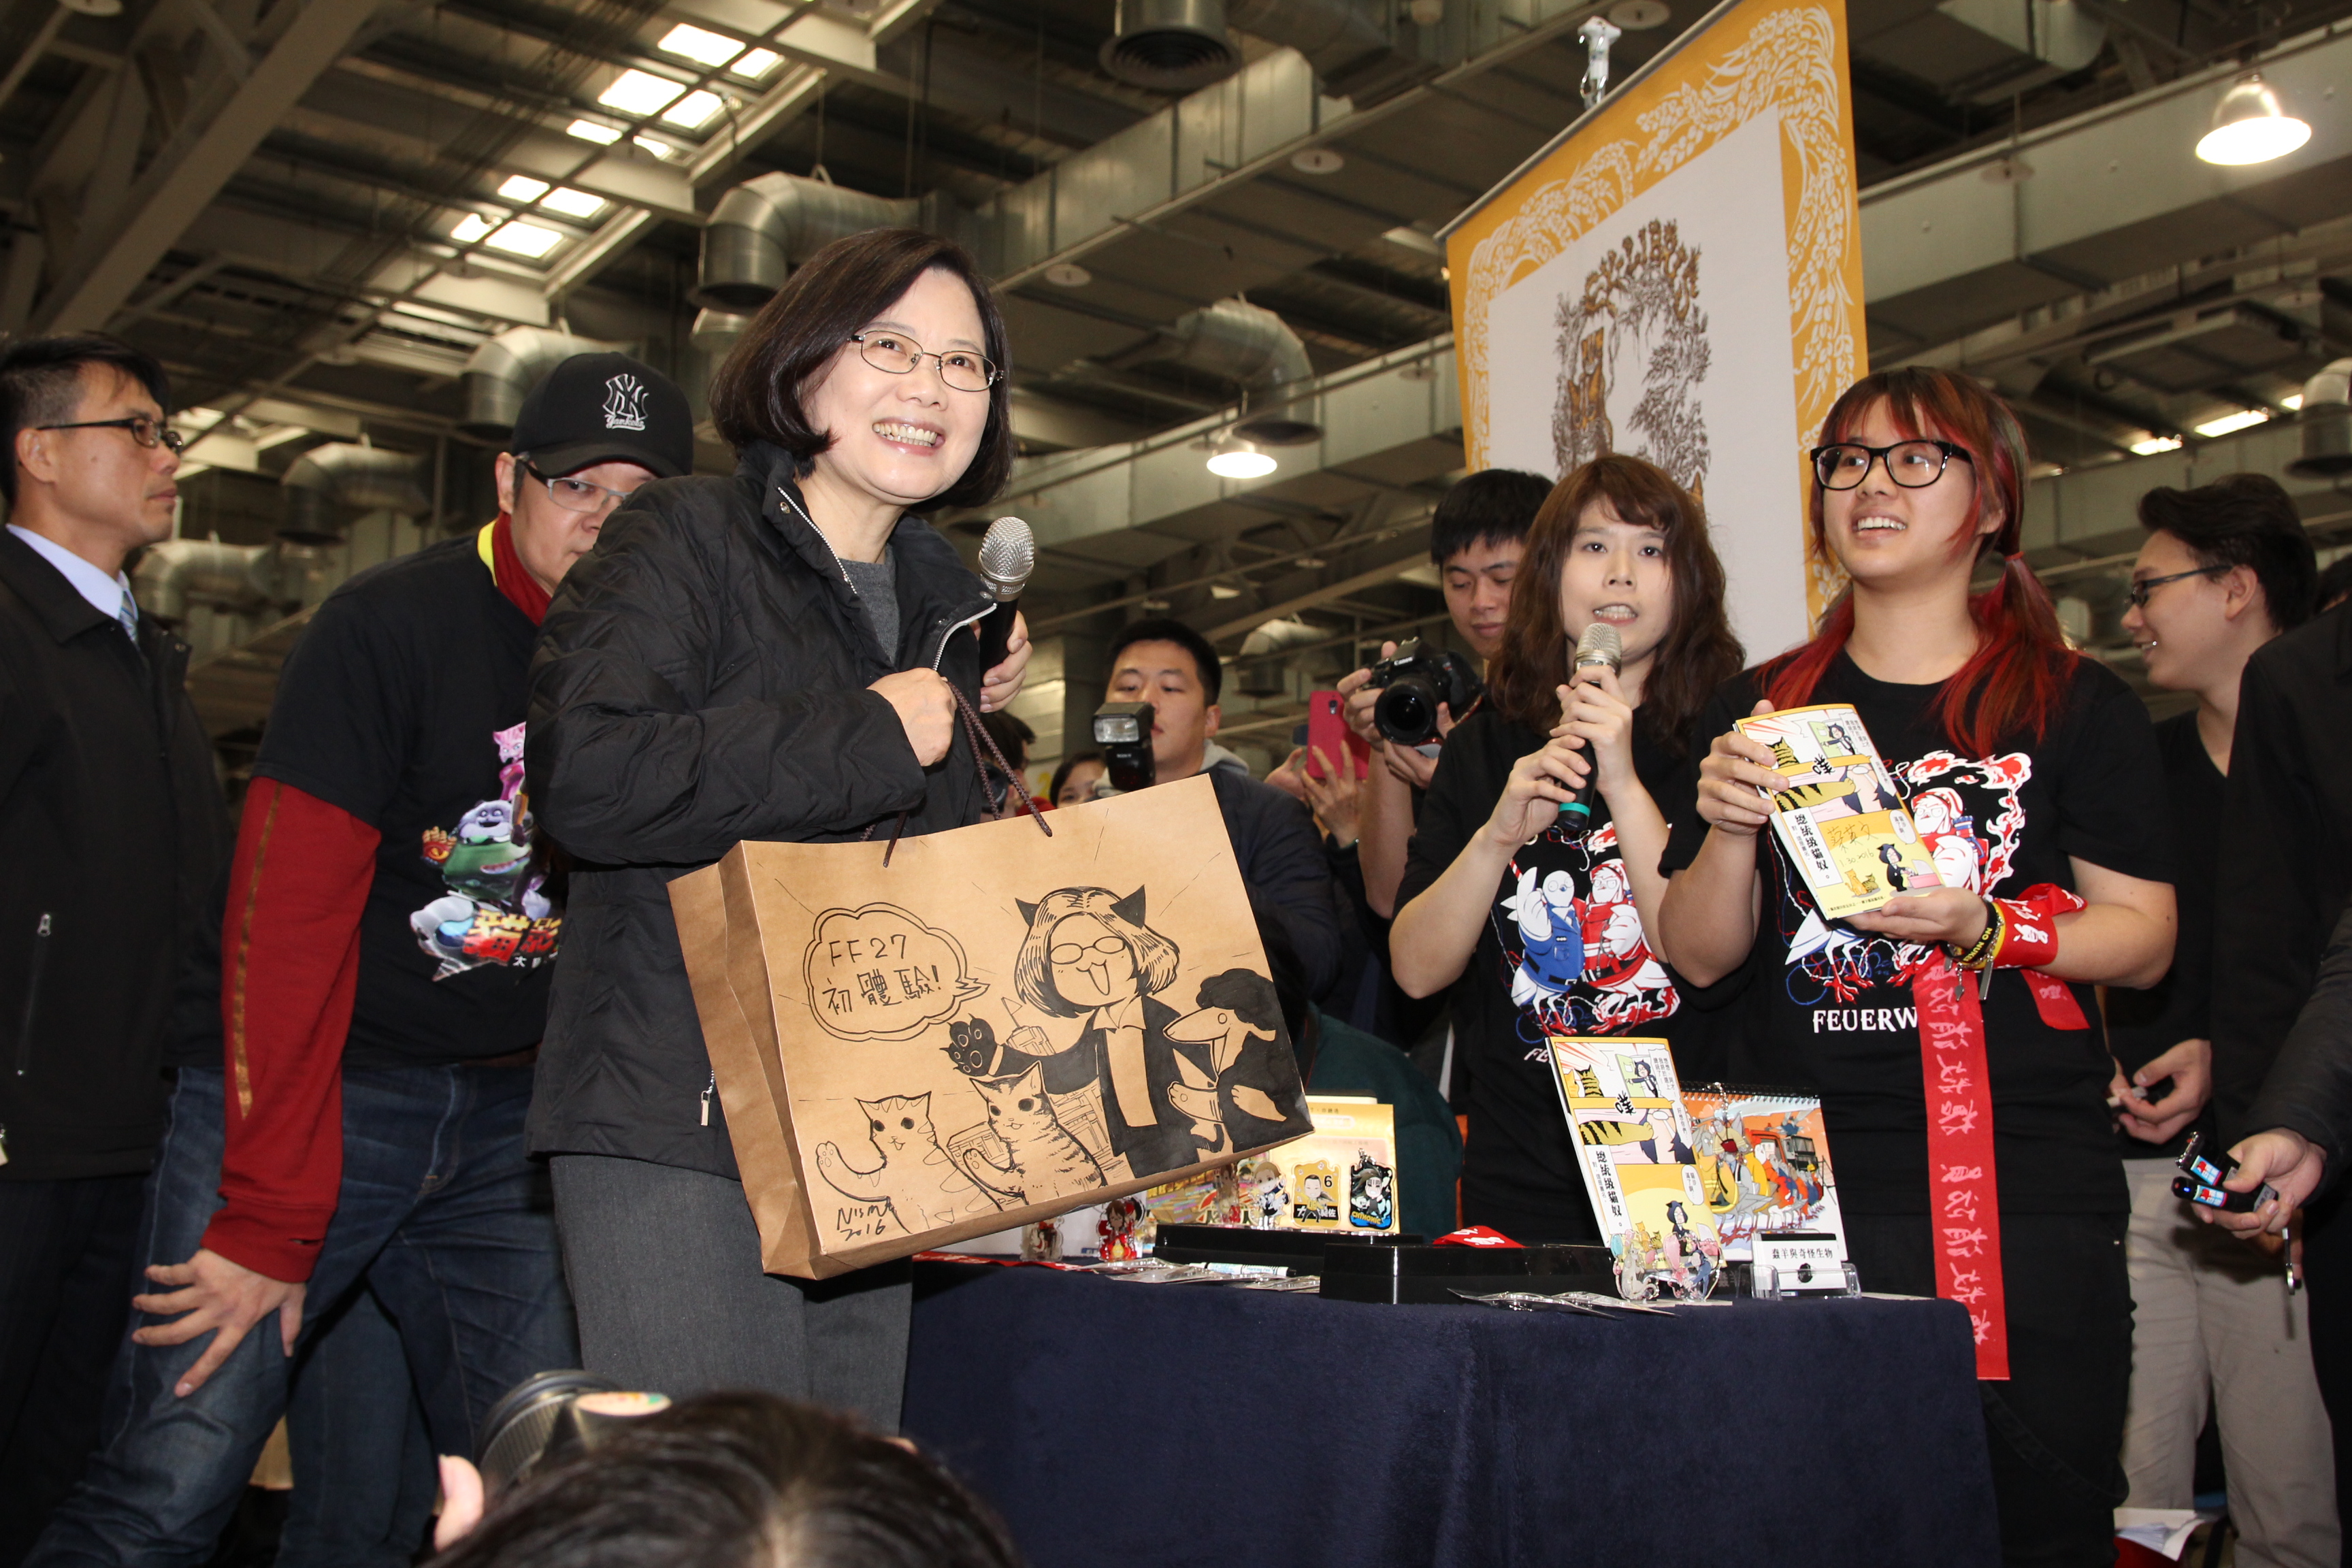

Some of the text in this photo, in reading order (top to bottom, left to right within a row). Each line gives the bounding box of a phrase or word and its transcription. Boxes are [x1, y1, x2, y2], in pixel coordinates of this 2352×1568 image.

[1393, 656, 1414, 666] Canon
[1981, 927, 1993, 941] NO
[1324, 1175, 1333, 1188] 6
[839, 1218, 886, 1241] 2016
